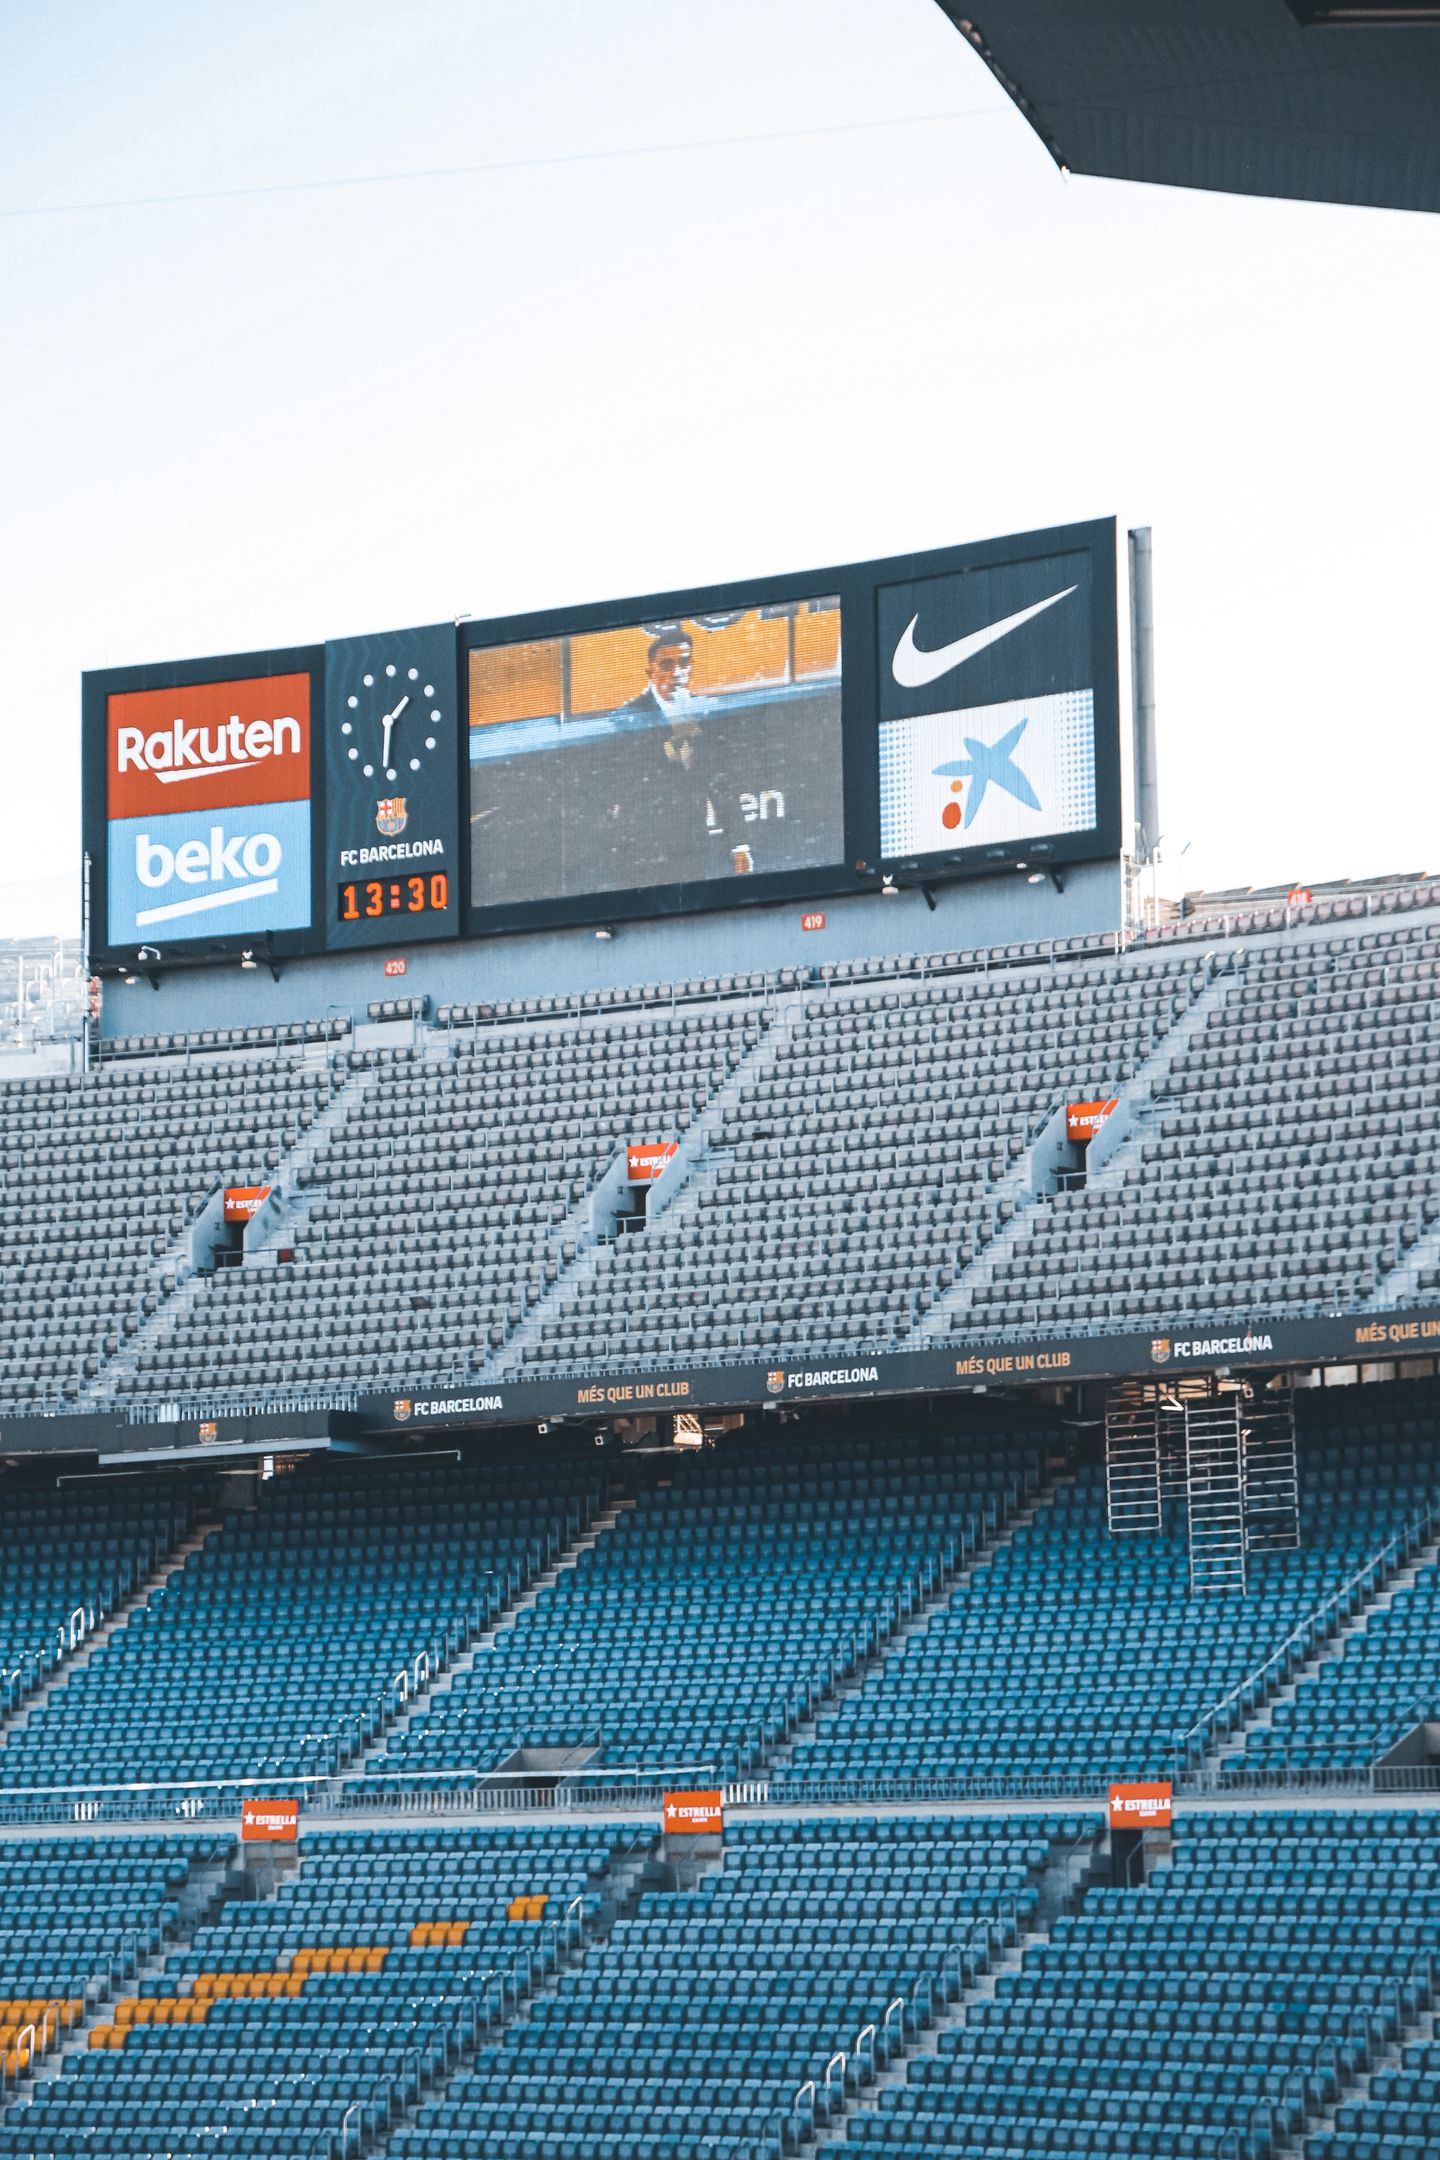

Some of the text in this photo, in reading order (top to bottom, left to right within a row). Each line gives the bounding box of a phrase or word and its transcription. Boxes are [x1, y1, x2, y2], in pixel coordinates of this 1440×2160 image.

[118, 715, 300, 773] Rakuten
[135, 826, 282, 888] beko
[340, 838, 444, 867] FC BARCELONA
[343, 874, 448, 920] 13:30
[804, 915, 823, 929] 419
[385, 961, 405, 975] 420
[1355, 1322, 1388, 1343] MÉS
[1389, 1322, 1420, 1343] QUE
[1173, 1334, 1273, 1358] FC BARCELONA
[956, 1352, 1071, 1376] MÉS QUE UN CLUB
[787, 1366, 879, 1388] FC BARCELONA
[577, 1382, 690, 1404] MÉS QUE UN CLUB
[414, 1395, 503, 1416] FC BARCELONA
[678, 1806, 721, 1818] ESTRELLA
[1124, 1798, 1171, 1811] ESTRELLA
[255, 1814, 297, 1825] ESTRELLA
